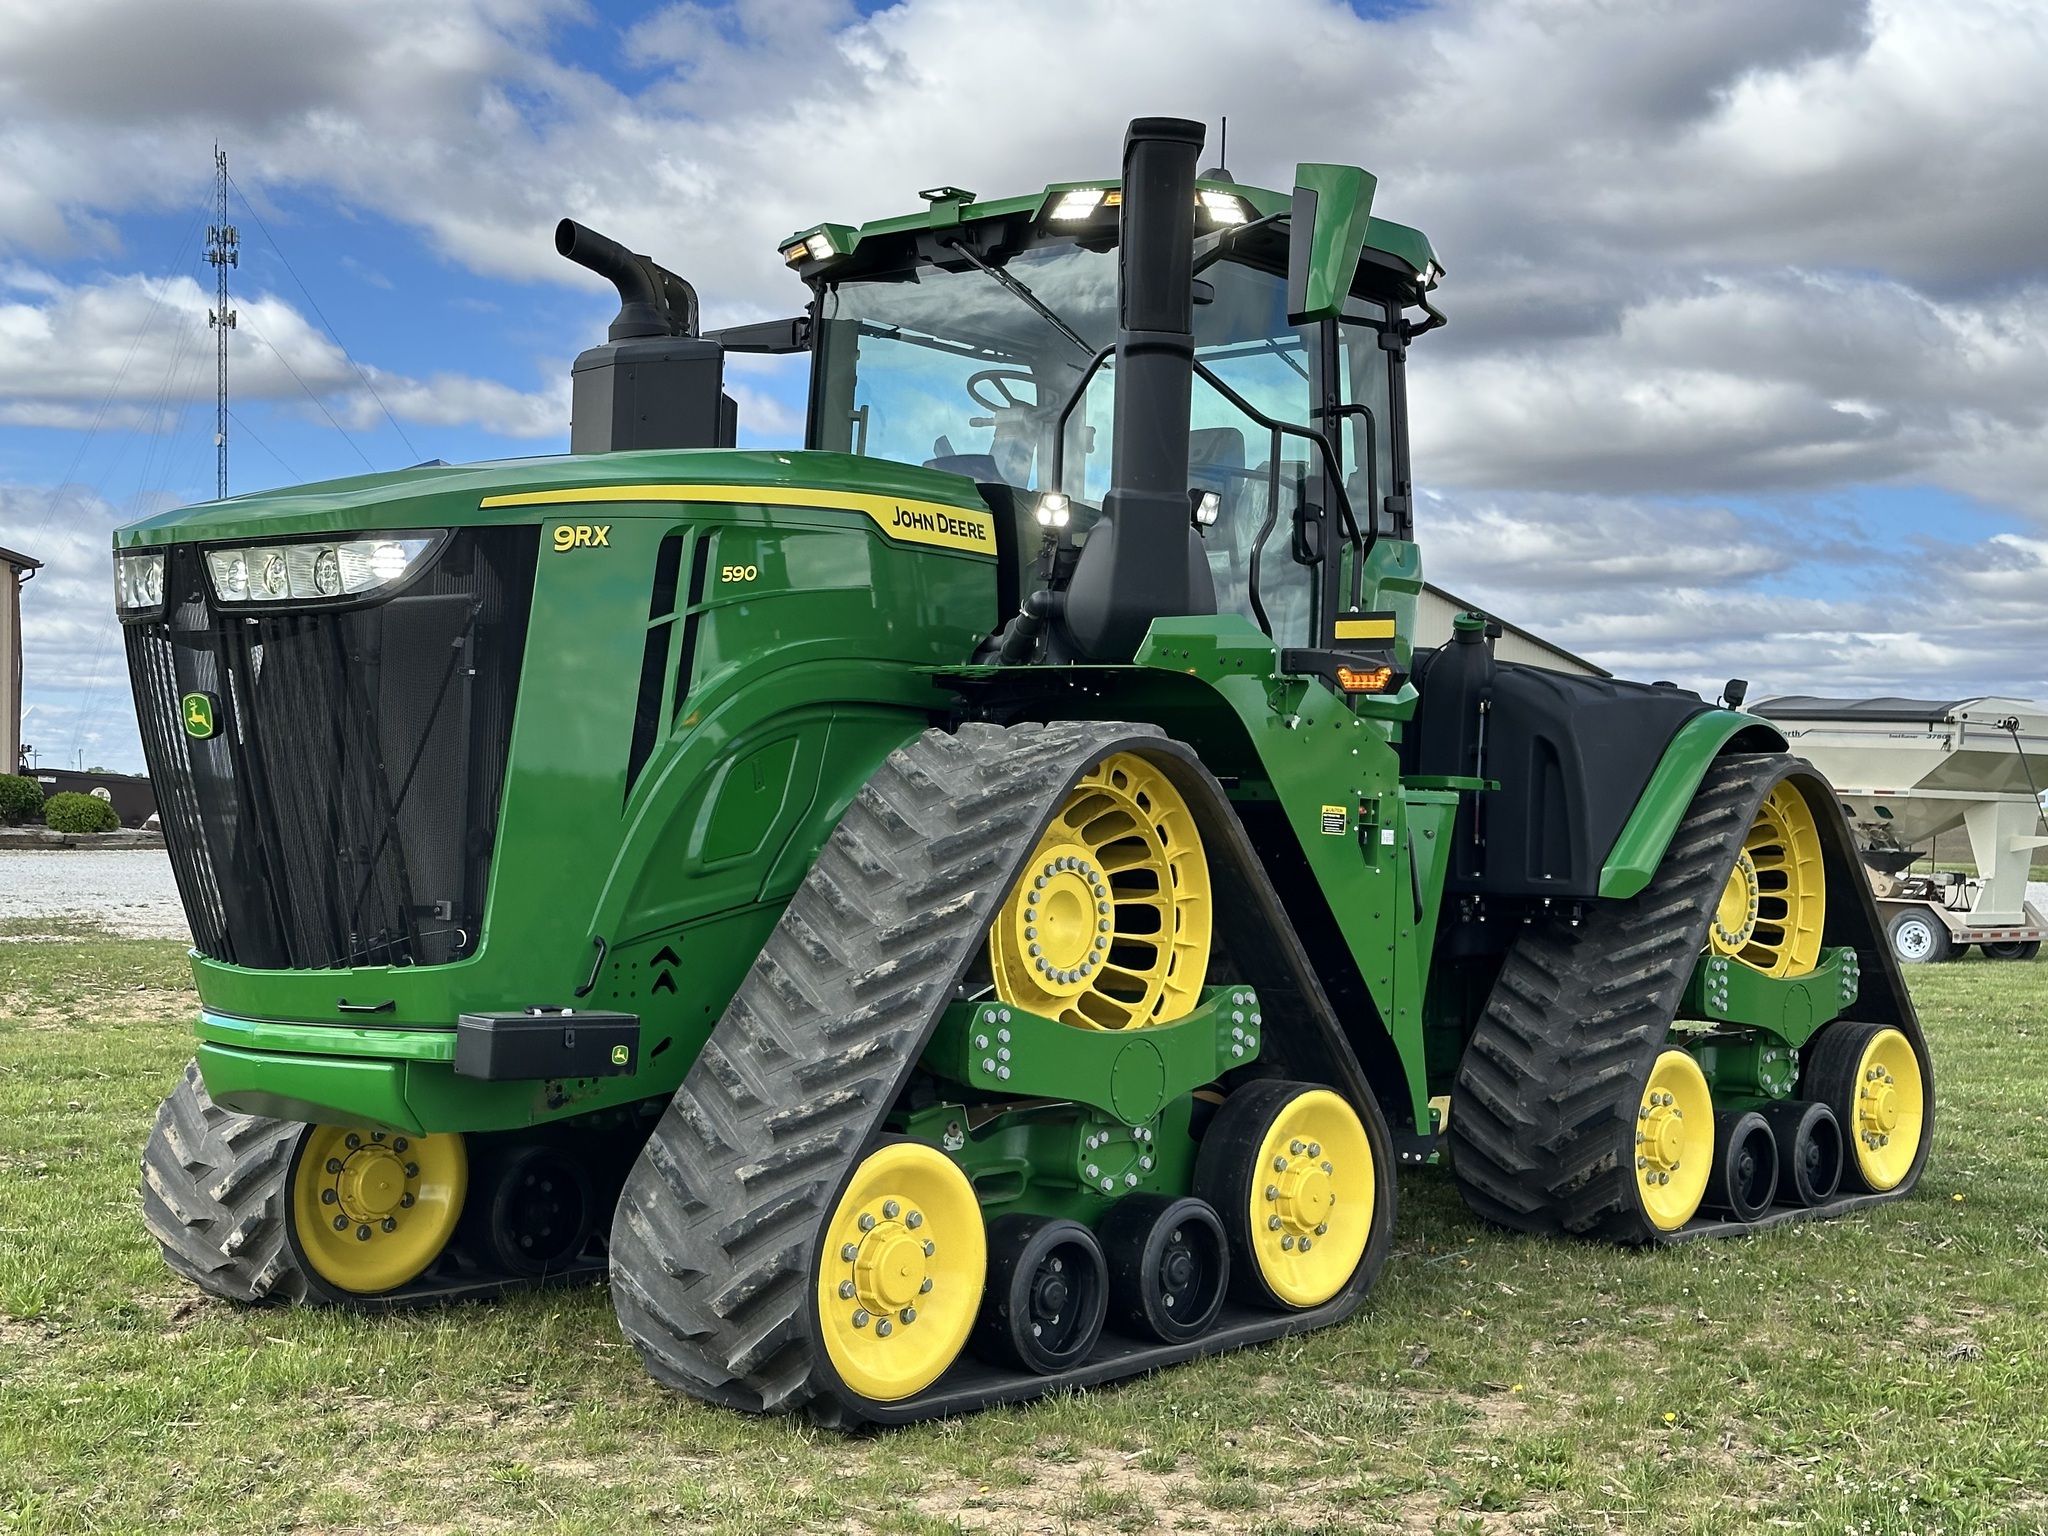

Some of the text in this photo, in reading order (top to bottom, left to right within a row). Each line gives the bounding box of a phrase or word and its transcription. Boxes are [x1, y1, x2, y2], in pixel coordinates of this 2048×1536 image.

[893, 505, 986, 540] JOHN DEERE
[553, 525, 611, 551] 9RX
[721, 565, 757, 582] 590
